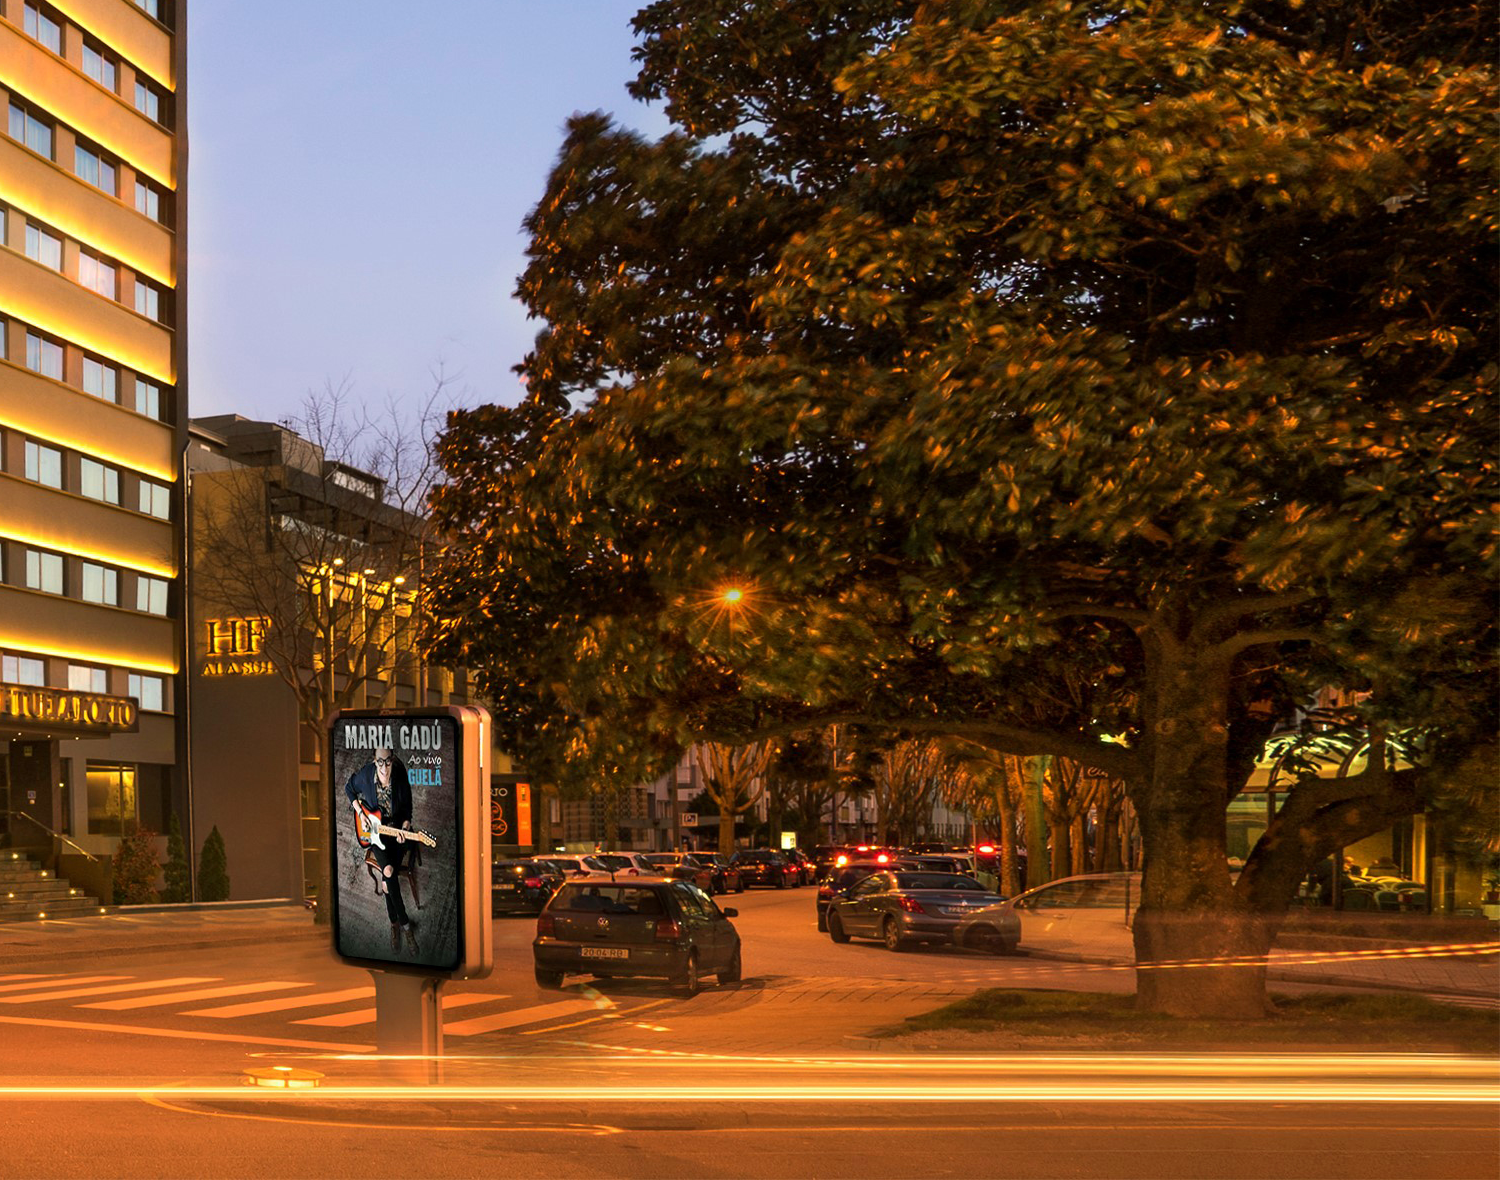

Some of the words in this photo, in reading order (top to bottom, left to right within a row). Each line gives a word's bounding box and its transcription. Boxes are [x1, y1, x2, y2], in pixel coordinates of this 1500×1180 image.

[204, 616, 273, 656] HF
[345, 724, 393, 750] MARIA
[400, 719, 442, 750] GADÚ
[408, 754, 420, 765] Ao
[424, 752, 442, 765] vivo
